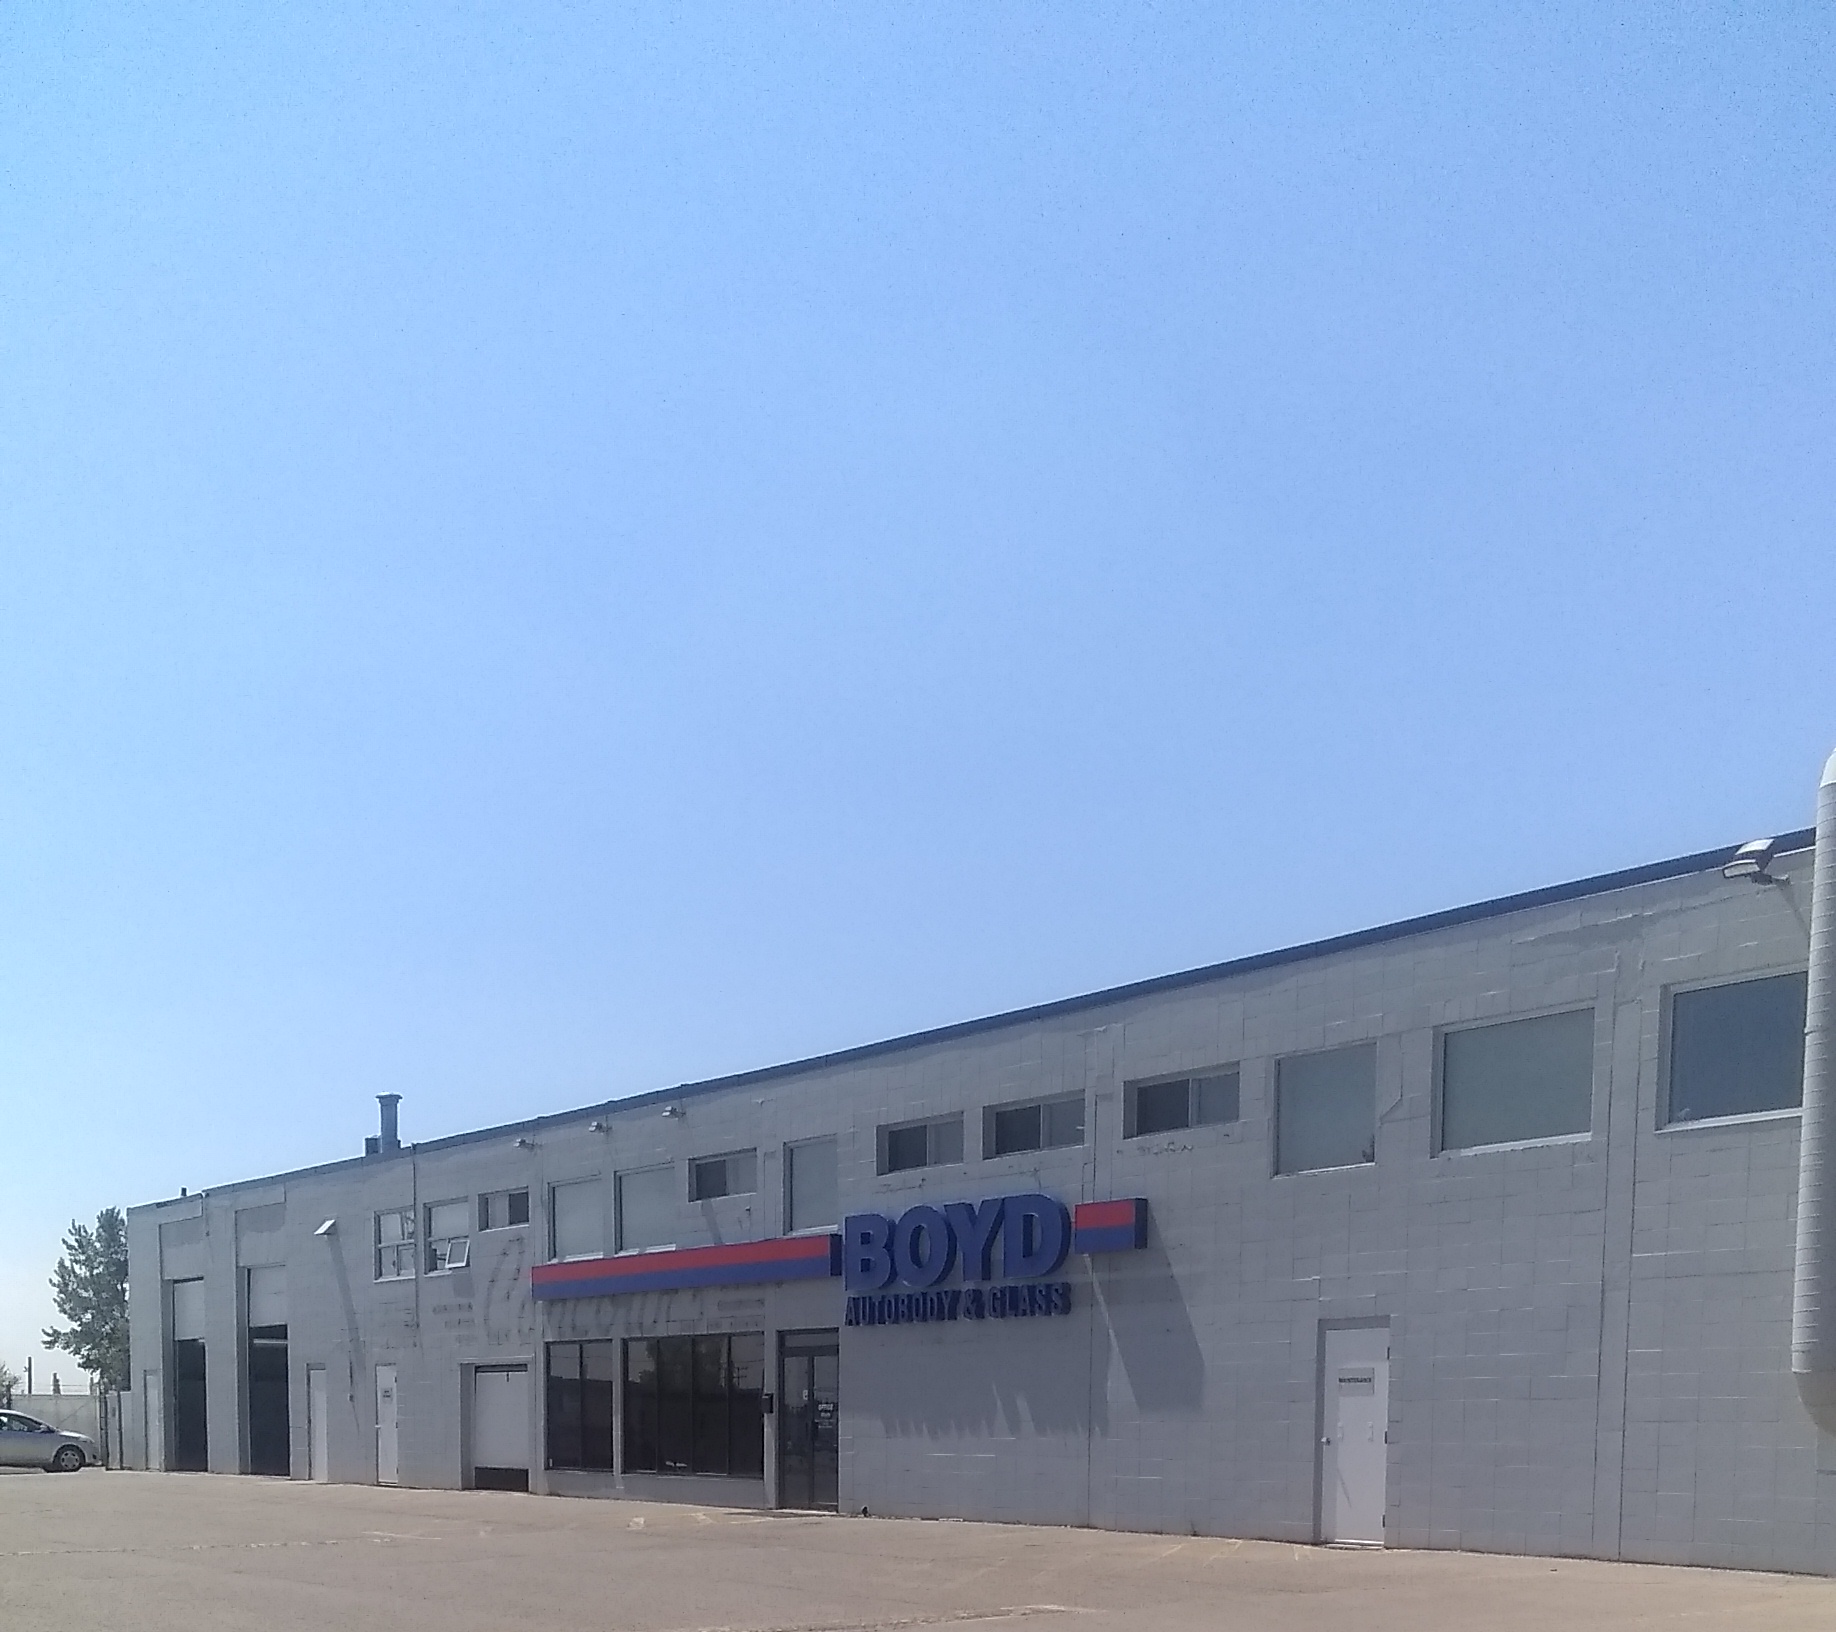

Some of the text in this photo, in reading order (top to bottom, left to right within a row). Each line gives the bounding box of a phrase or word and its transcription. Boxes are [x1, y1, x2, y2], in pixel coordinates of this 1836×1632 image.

[844, 1193, 1072, 1291] BOYD
[844, 1281, 1072, 1326] AUTOBODY & GLASS
